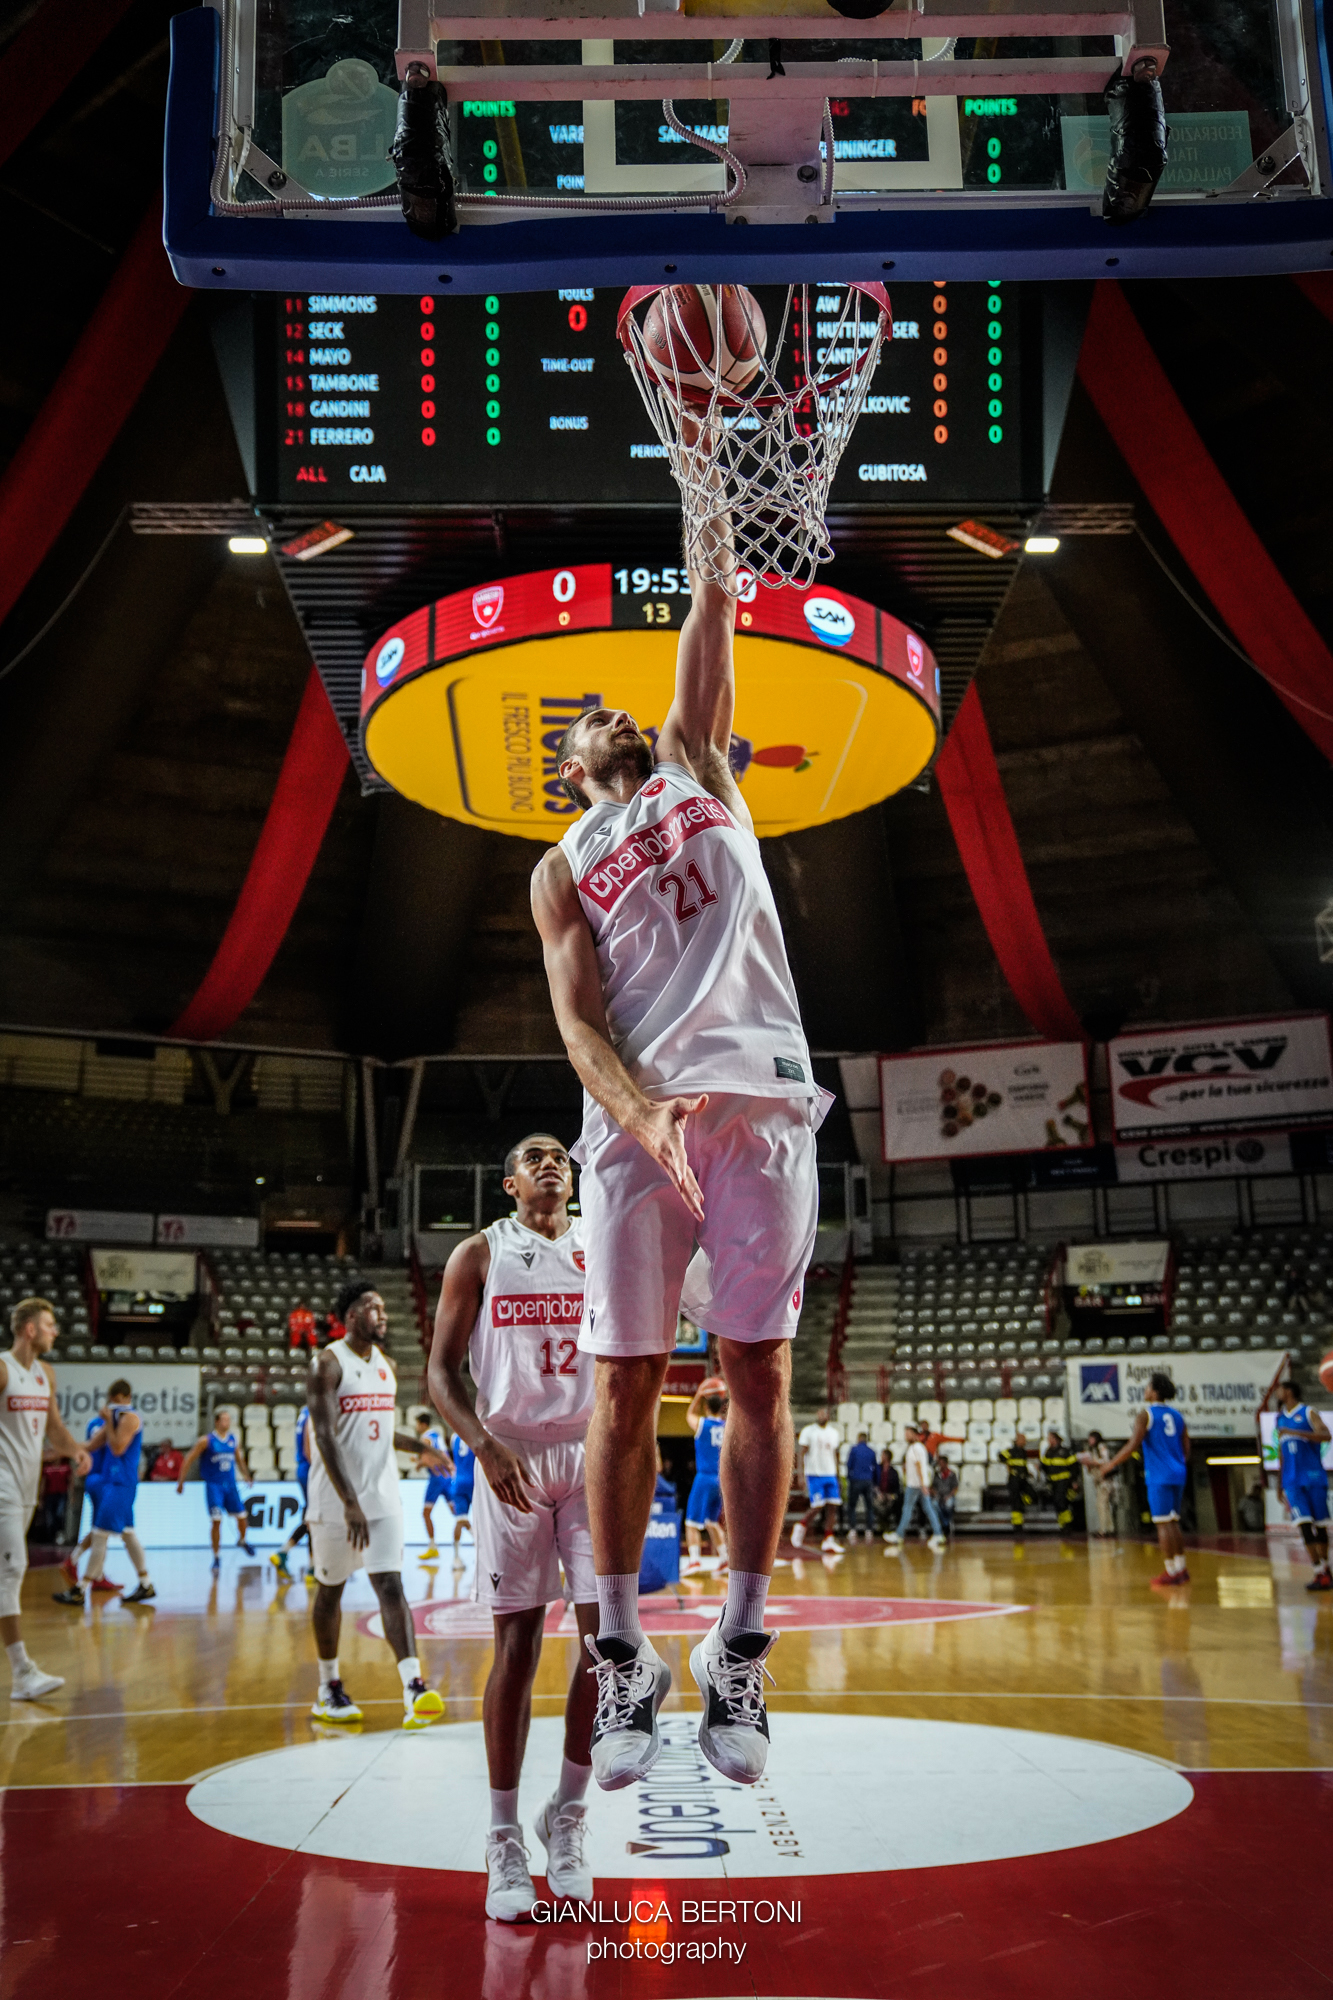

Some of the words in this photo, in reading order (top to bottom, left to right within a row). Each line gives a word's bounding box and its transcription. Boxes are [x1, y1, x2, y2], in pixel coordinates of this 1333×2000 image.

[462, 100, 516, 117] POINTS
[964, 98, 1018, 116] POINTS
[483, 140, 497, 159] 0
[986, 137, 1001, 159] 0
[483, 164, 498, 183] 0
[986, 163, 1001, 183] 0
[308, 296, 377, 313] SIMMONS
[420, 296, 434, 315] 0
[485, 295, 500, 315] 0
[933, 294, 948, 314] 0
[987, 294, 1002, 314] 0
[568, 304, 588, 332] 0
[308, 322, 345, 339] SECK
[421, 322, 435, 341] 0
[485, 322, 500, 341] 0
[933, 321, 948, 340] 0
[987, 320, 1002, 340] 0
[309, 348, 351, 365] MAYO
[421, 348, 435, 367] 0
[485, 348, 500, 367] 0
[541, 358, 595, 372] TIME-OUT
[933, 347, 948, 366] 0
[987, 347, 1002, 366] 0
[309, 374, 380, 392] TAMBONE
[421, 374, 435, 393] 0
[486, 374, 500, 393] 0
[933, 373, 948, 392] 0
[988, 373, 1003, 392] 0
[310, 400, 371, 418] GANDINI
[421, 400, 436, 419] 0
[486, 400, 500, 419] 0
[934, 398, 948, 418] 0
[988, 399, 1003, 418] 0
[550, 416, 588, 430] BONUS
[285, 429, 304, 445] 21
[310, 427, 374, 445] FERRERO
[421, 427, 436, 446] 0
[486, 427, 501, 446] 0
[934, 425, 949, 444] 0
[988, 425, 1003, 444] 0
[296, 466, 328, 483] ALL
[349, 465, 387, 483] CAJA
[858, 464, 928, 482] GUBITOSA
[553, 570, 576, 602] 0
[642, 602, 671, 624] 13
[503, 706, 531, 754] FRESCO
[508, 775, 535, 813] BUONO
[656, 858, 719, 926] 21
[1227, 1080, 1252, 1096] tua
[1256, 1075, 1329, 1093] sicurezza
[1137, 1138, 1232, 1171] Crespi
[540, 1338, 579, 1377] 12
[1081, 1382, 1116, 1401] AXA
[1201, 1383, 1256, 1402] TRADING
[368, 1419, 380, 1441] 3
[1163, 1412, 1177, 1438] 3
[756, 1797, 806, 1859] AGENZIA
